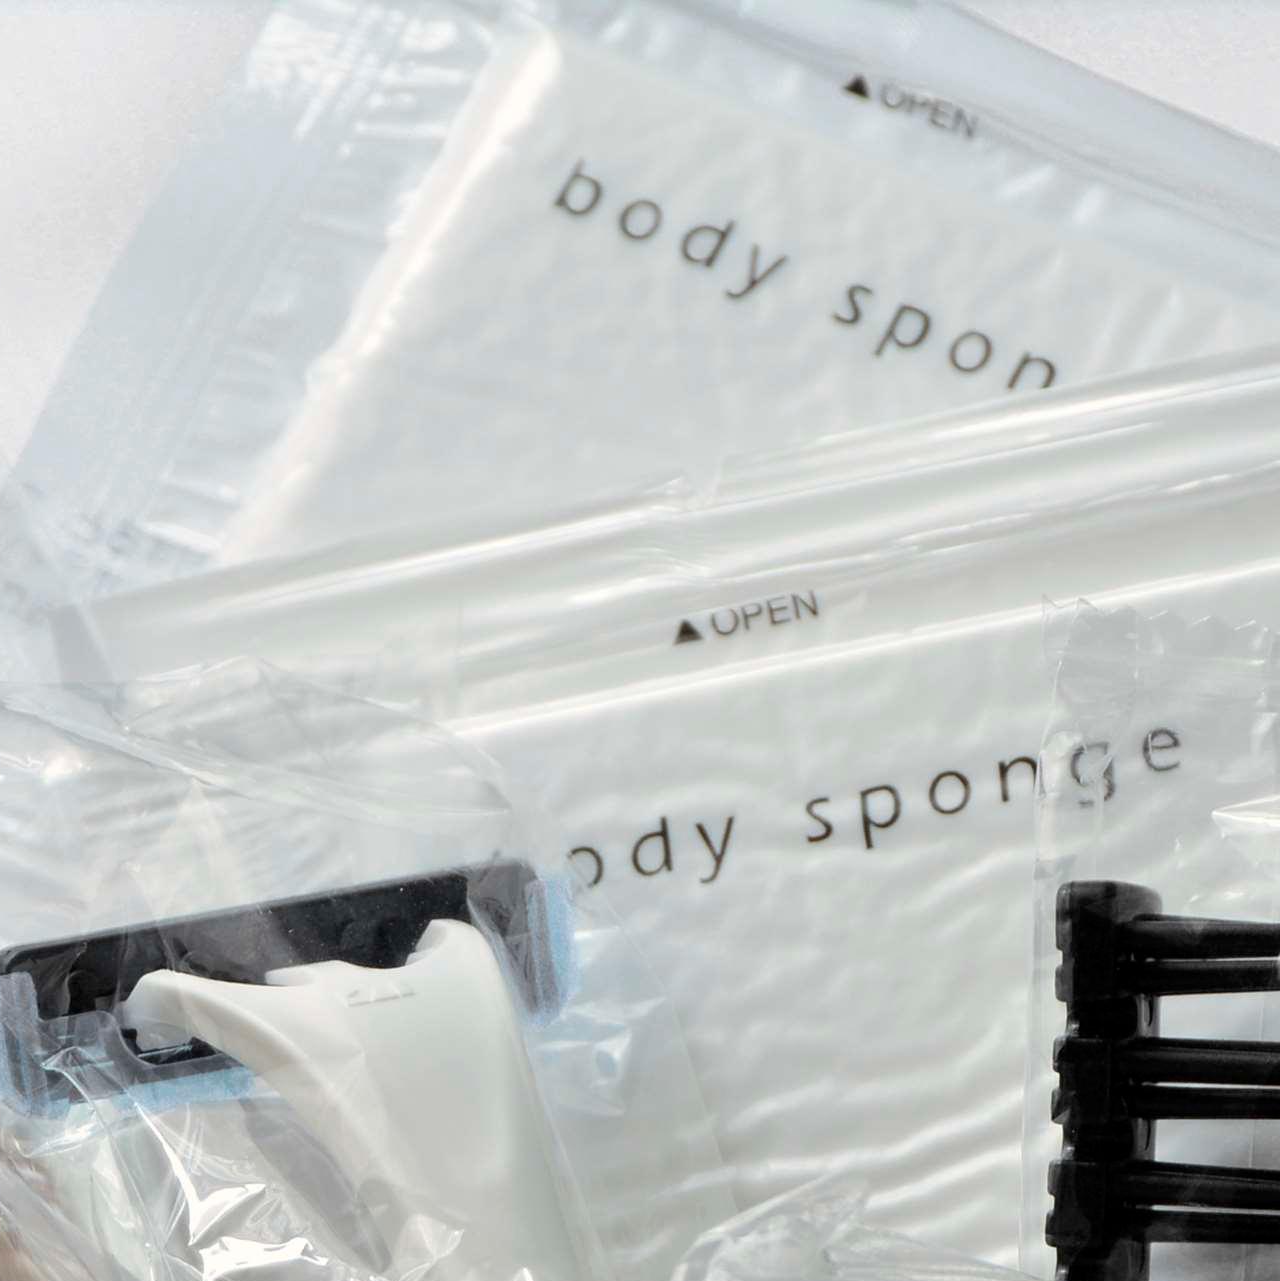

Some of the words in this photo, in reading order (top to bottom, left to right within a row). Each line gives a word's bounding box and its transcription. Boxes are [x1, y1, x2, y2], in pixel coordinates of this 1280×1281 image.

[878, 84, 980, 138] OPEN
[552, 159, 787, 301] body
[708, 590, 821, 637] OPEN
[567, 816, 736, 884] ody
[804, 726, 1181, 848] sponge
